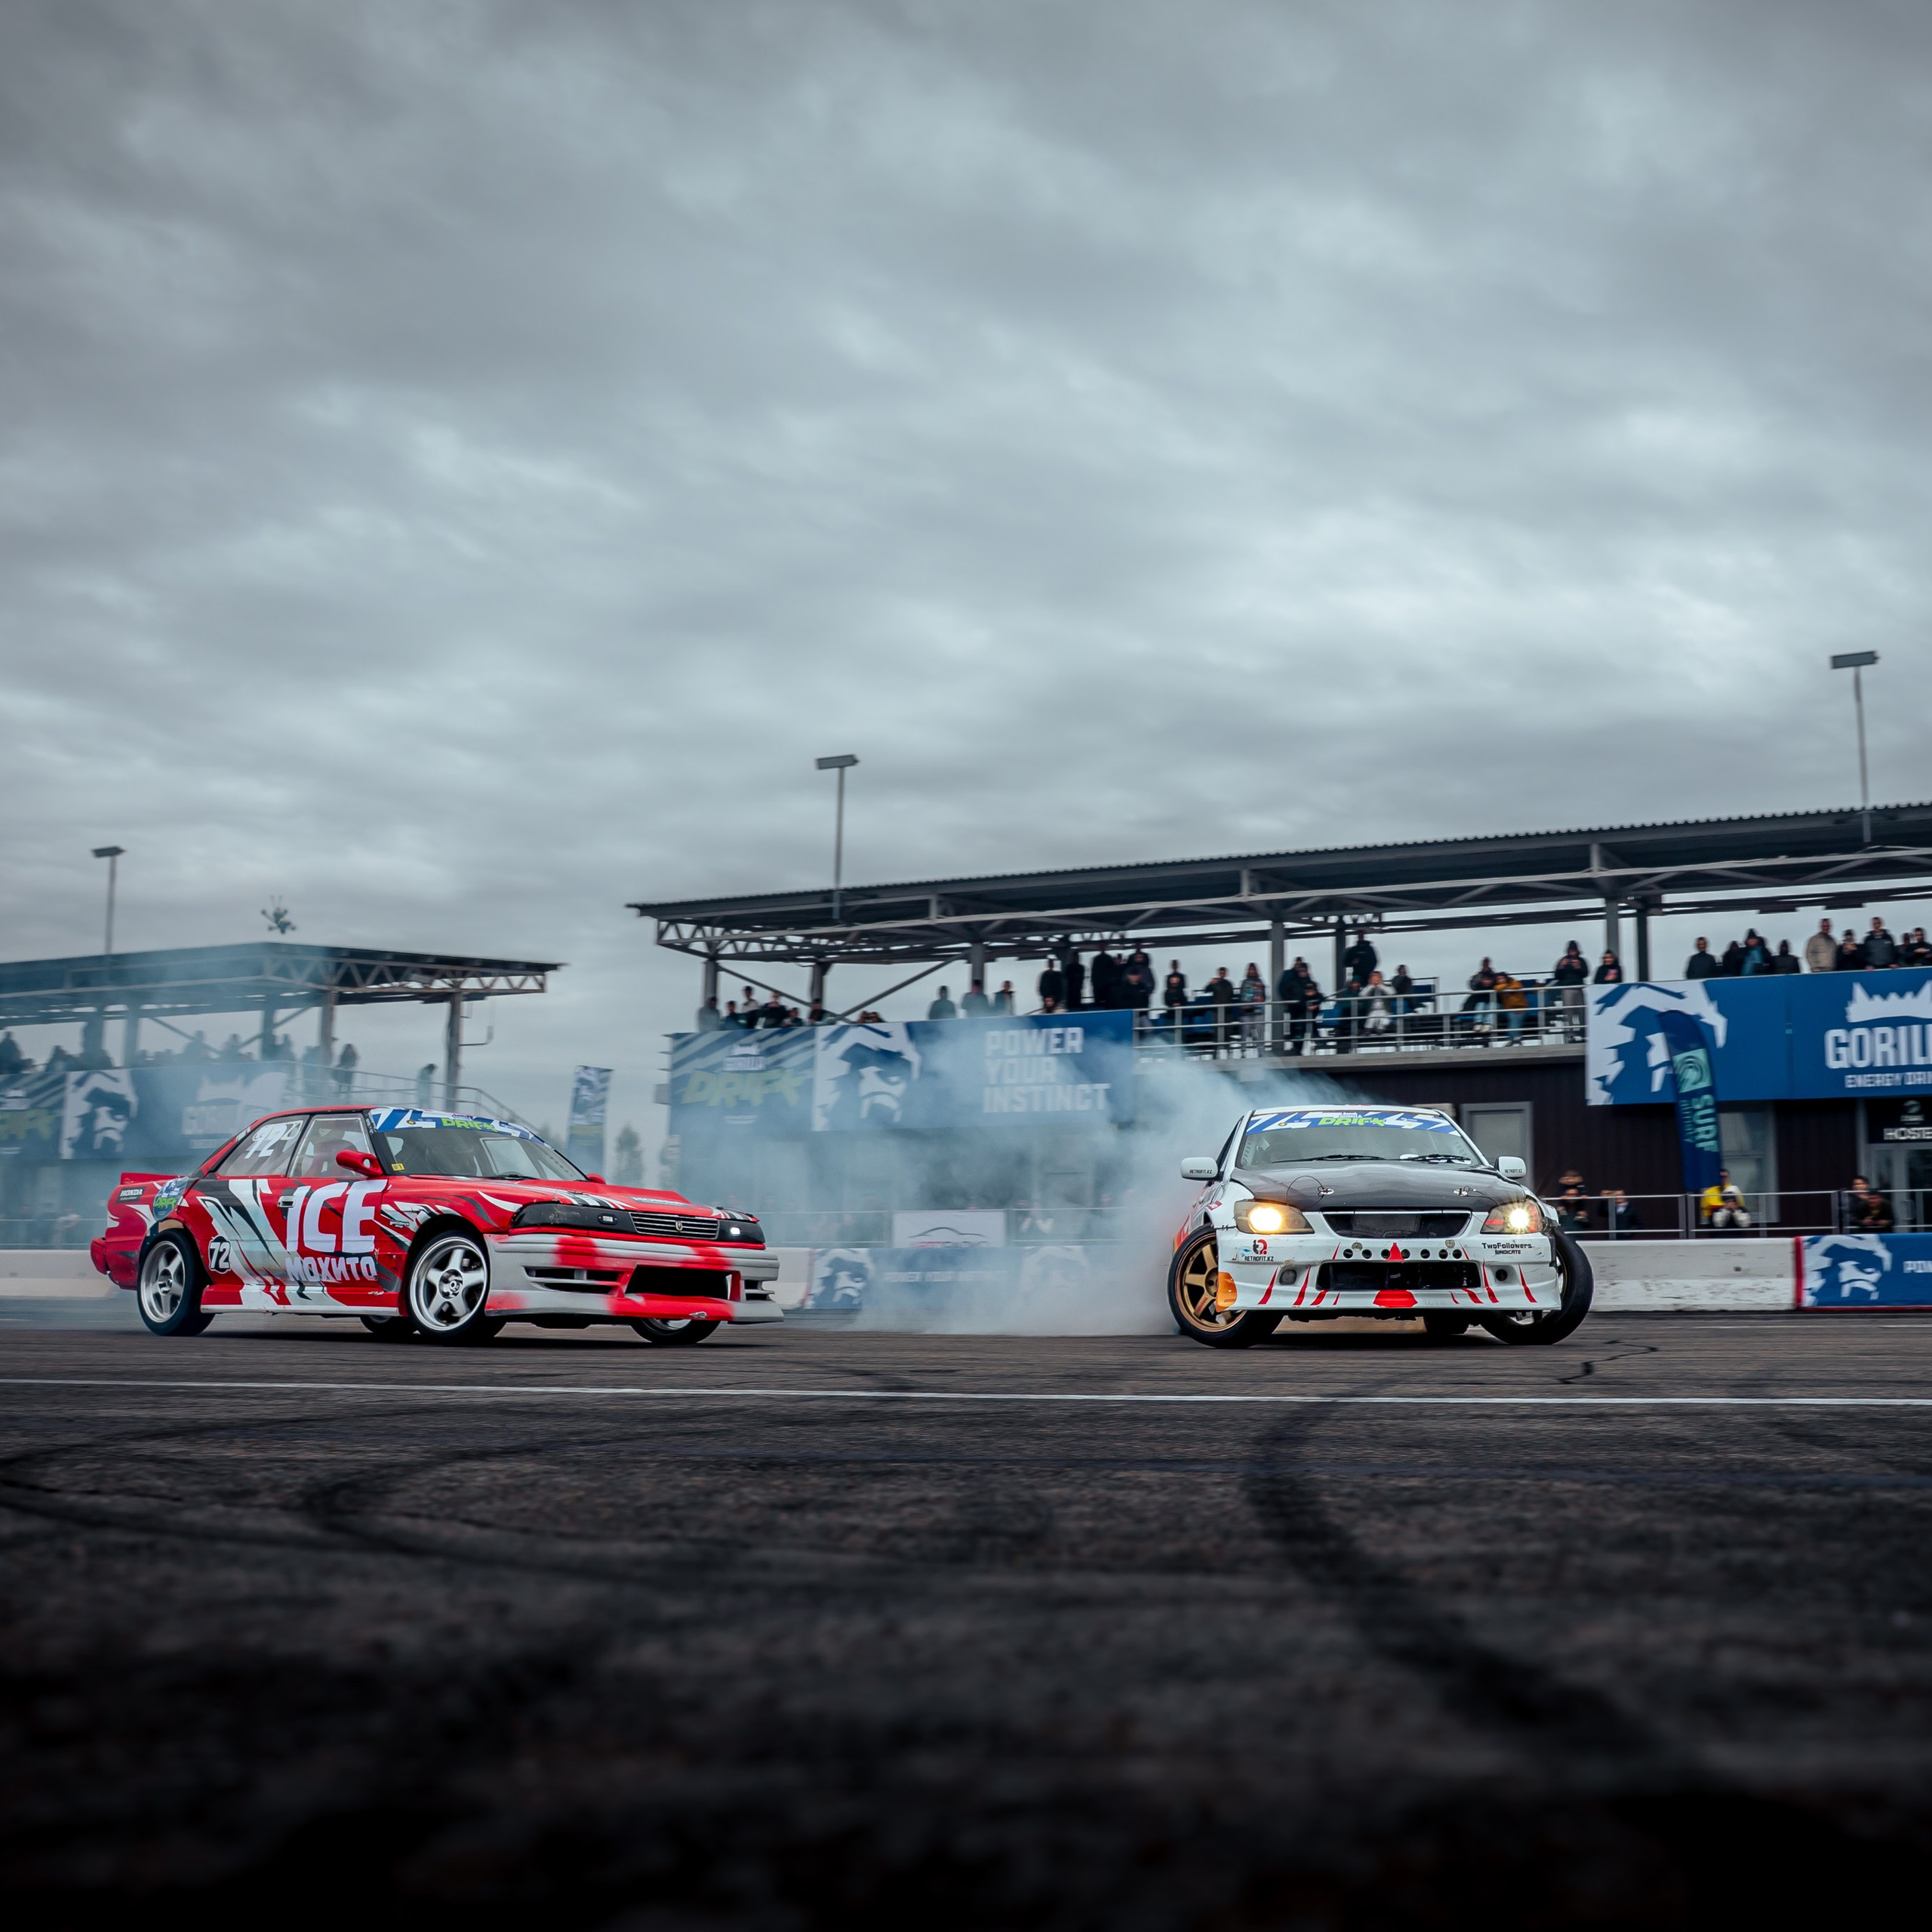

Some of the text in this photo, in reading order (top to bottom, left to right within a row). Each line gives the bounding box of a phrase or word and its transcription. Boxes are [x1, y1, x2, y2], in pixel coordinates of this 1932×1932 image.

[985, 1027, 1084, 1057] POWER
[984, 1057, 1057, 1084] YOUR
[984, 1083, 1111, 1113] INSTINCT
[286, 1180, 388, 1253] ICE
[210, 1241, 230, 1269] 72
